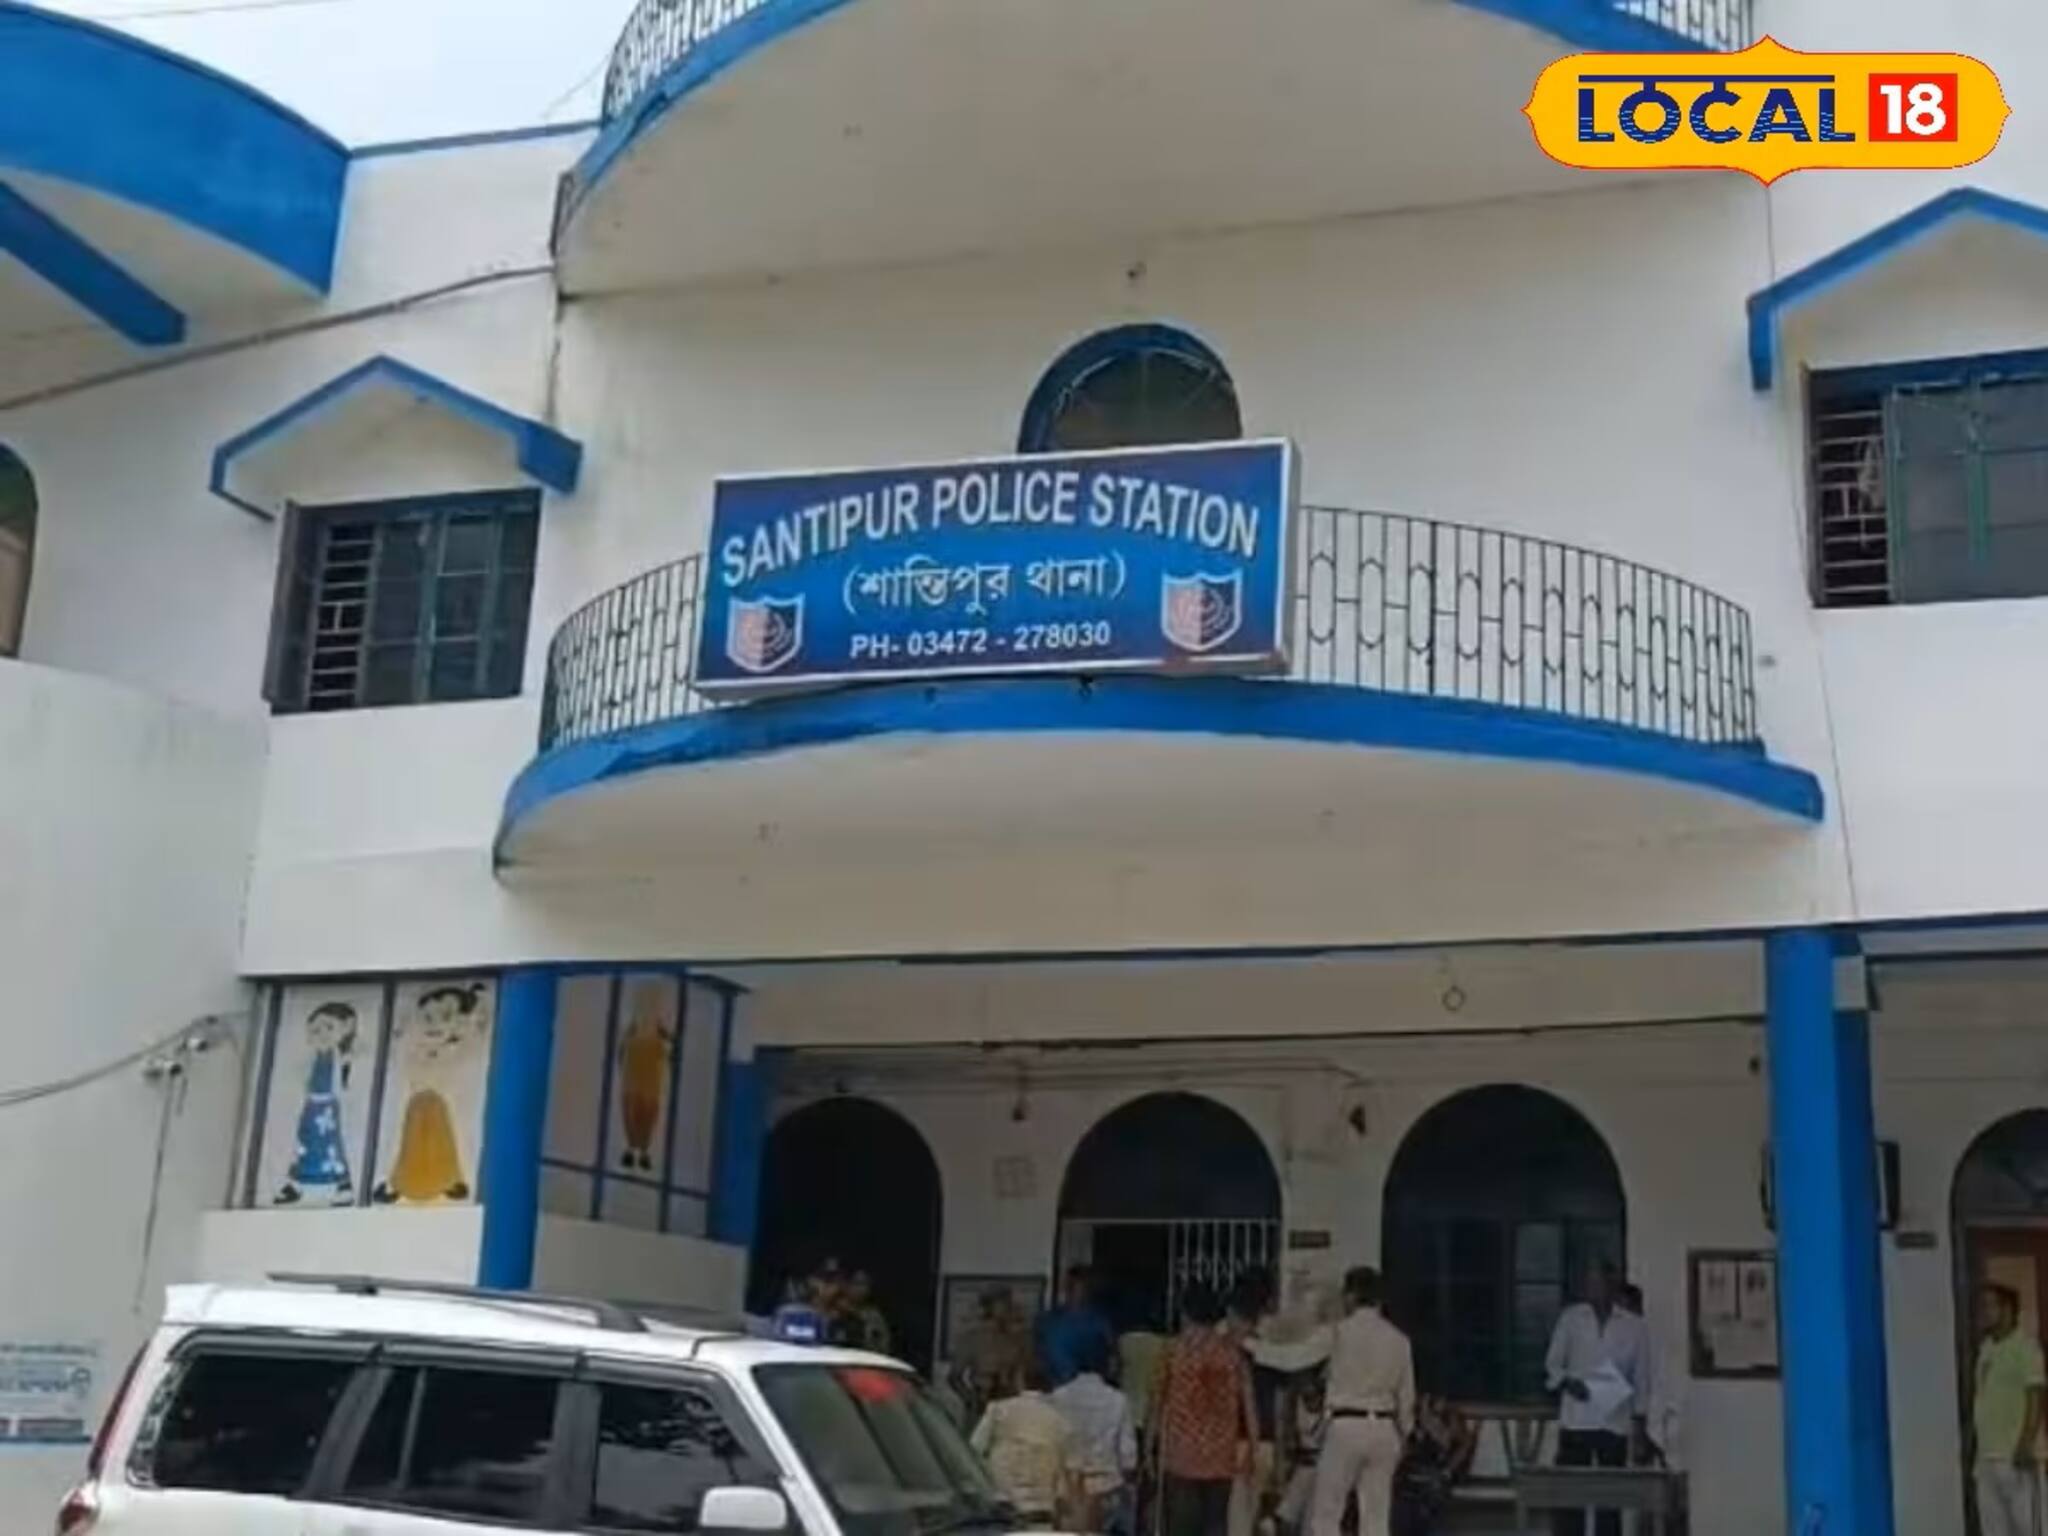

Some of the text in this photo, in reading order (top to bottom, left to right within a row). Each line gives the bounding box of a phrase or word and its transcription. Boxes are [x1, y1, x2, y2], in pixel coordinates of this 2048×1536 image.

[722, 470, 1259, 588] SANTIPUR POLICE STATION
[906, 627, 988, 656] 03472
[1013, 620, 1112, 652] 278030
